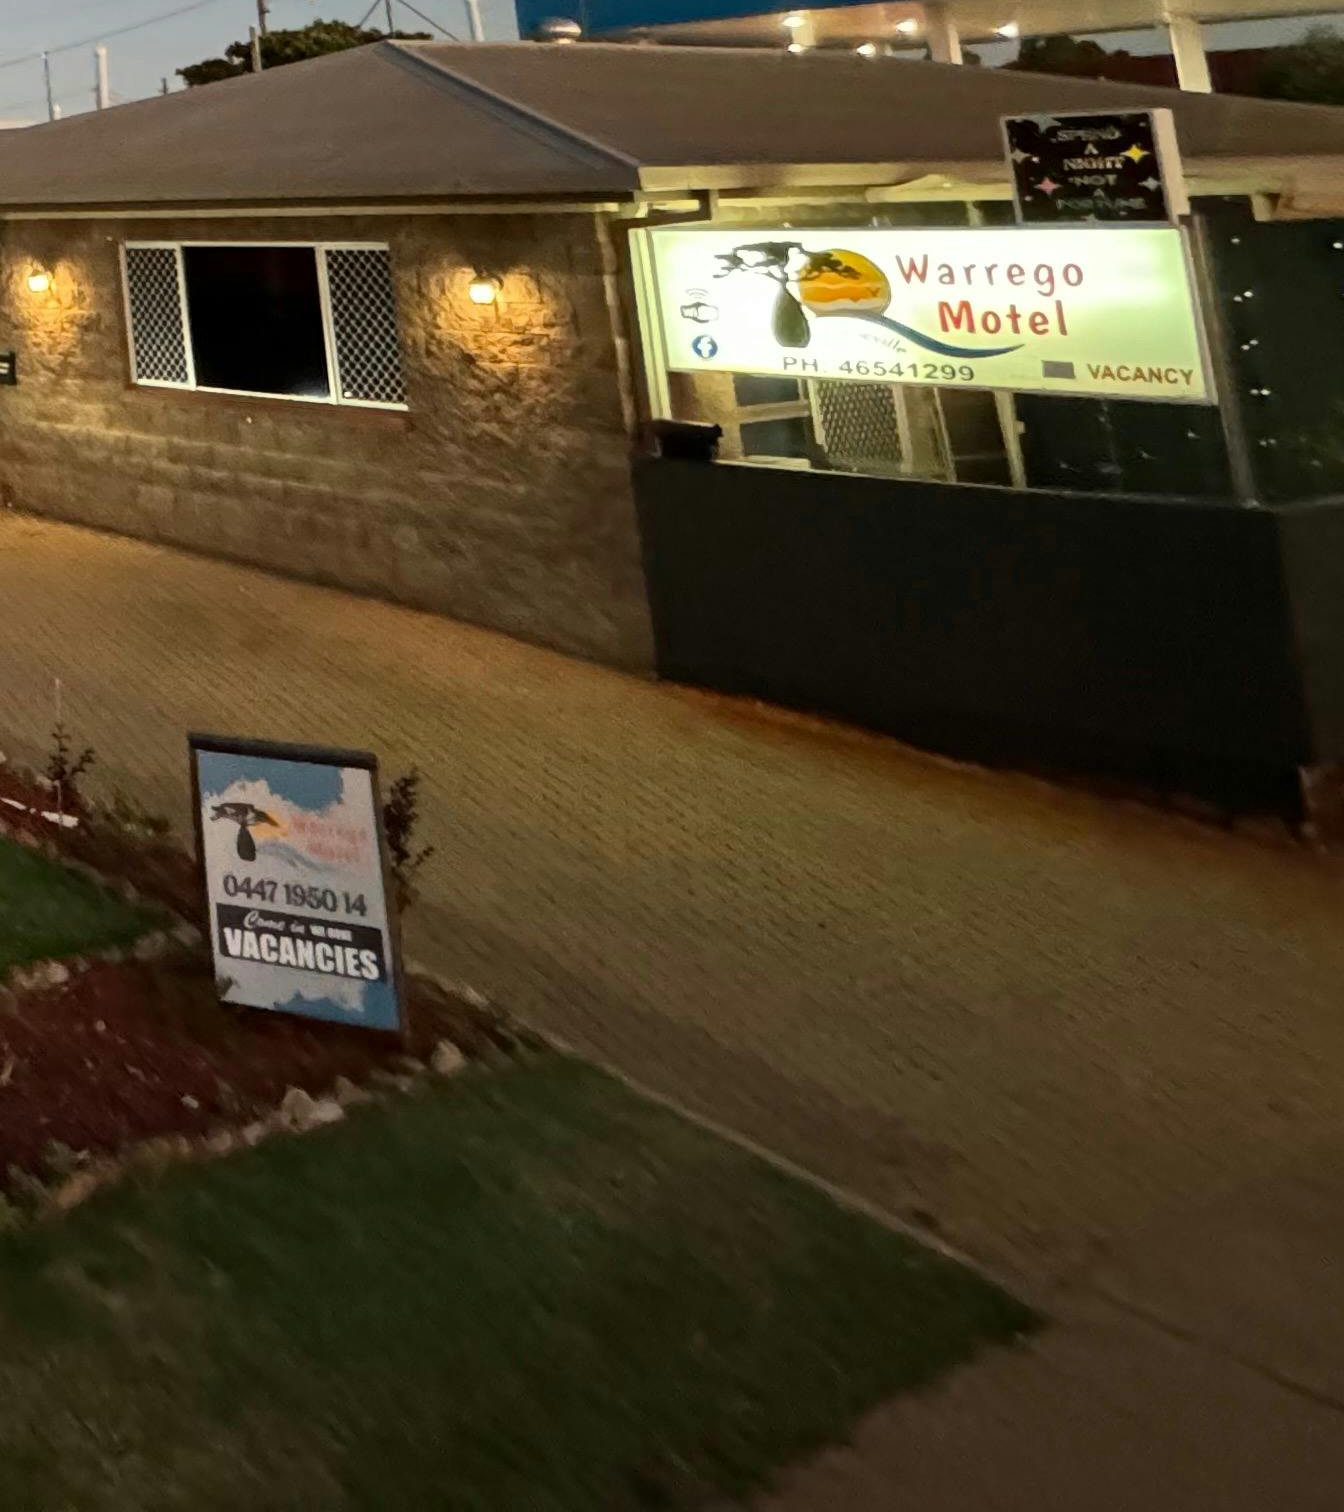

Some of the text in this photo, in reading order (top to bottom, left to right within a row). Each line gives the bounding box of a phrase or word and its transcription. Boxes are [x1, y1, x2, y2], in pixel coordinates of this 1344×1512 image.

[895, 253, 1084, 296] Warrego
[937, 300, 1069, 337] Motel
[839, 359, 975, 382] 46541299
[1087, 362, 1194, 386] VACANCY
[223, 926, 380, 981] VACANCIES
